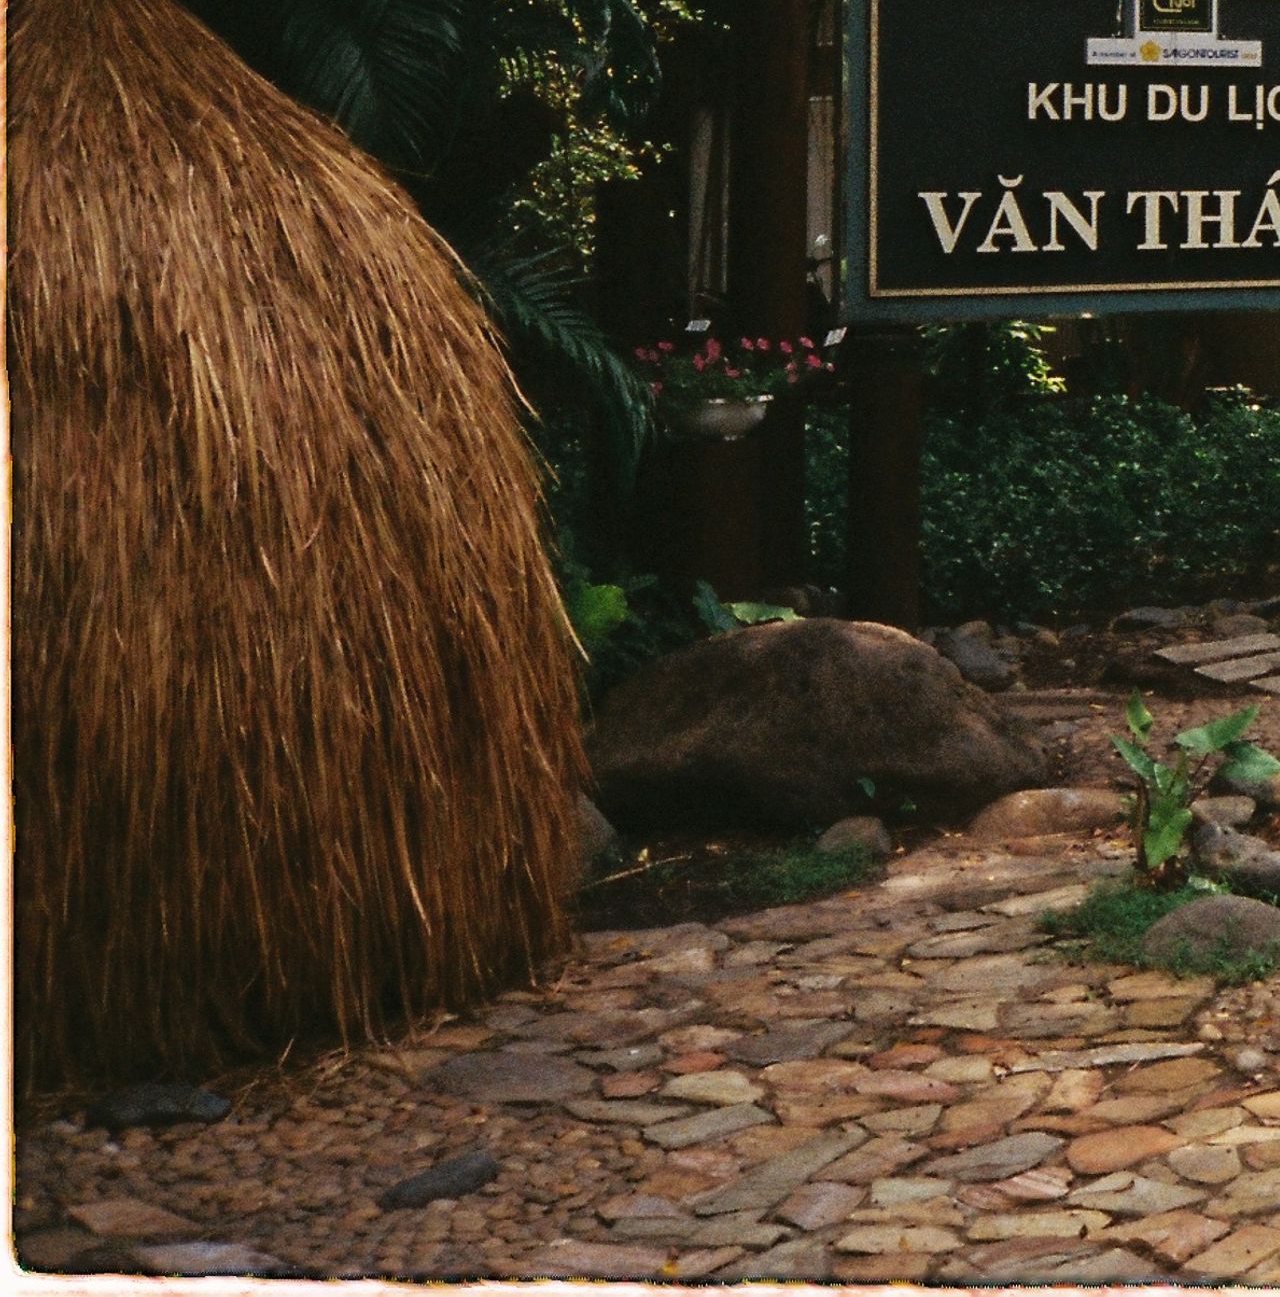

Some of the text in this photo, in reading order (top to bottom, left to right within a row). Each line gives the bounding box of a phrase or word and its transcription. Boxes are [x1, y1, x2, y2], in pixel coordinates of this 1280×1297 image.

[1027, 82, 1128, 121] KHU
[1147, 84, 1209, 122] DU
[917, 174, 1106, 254] VĂN
